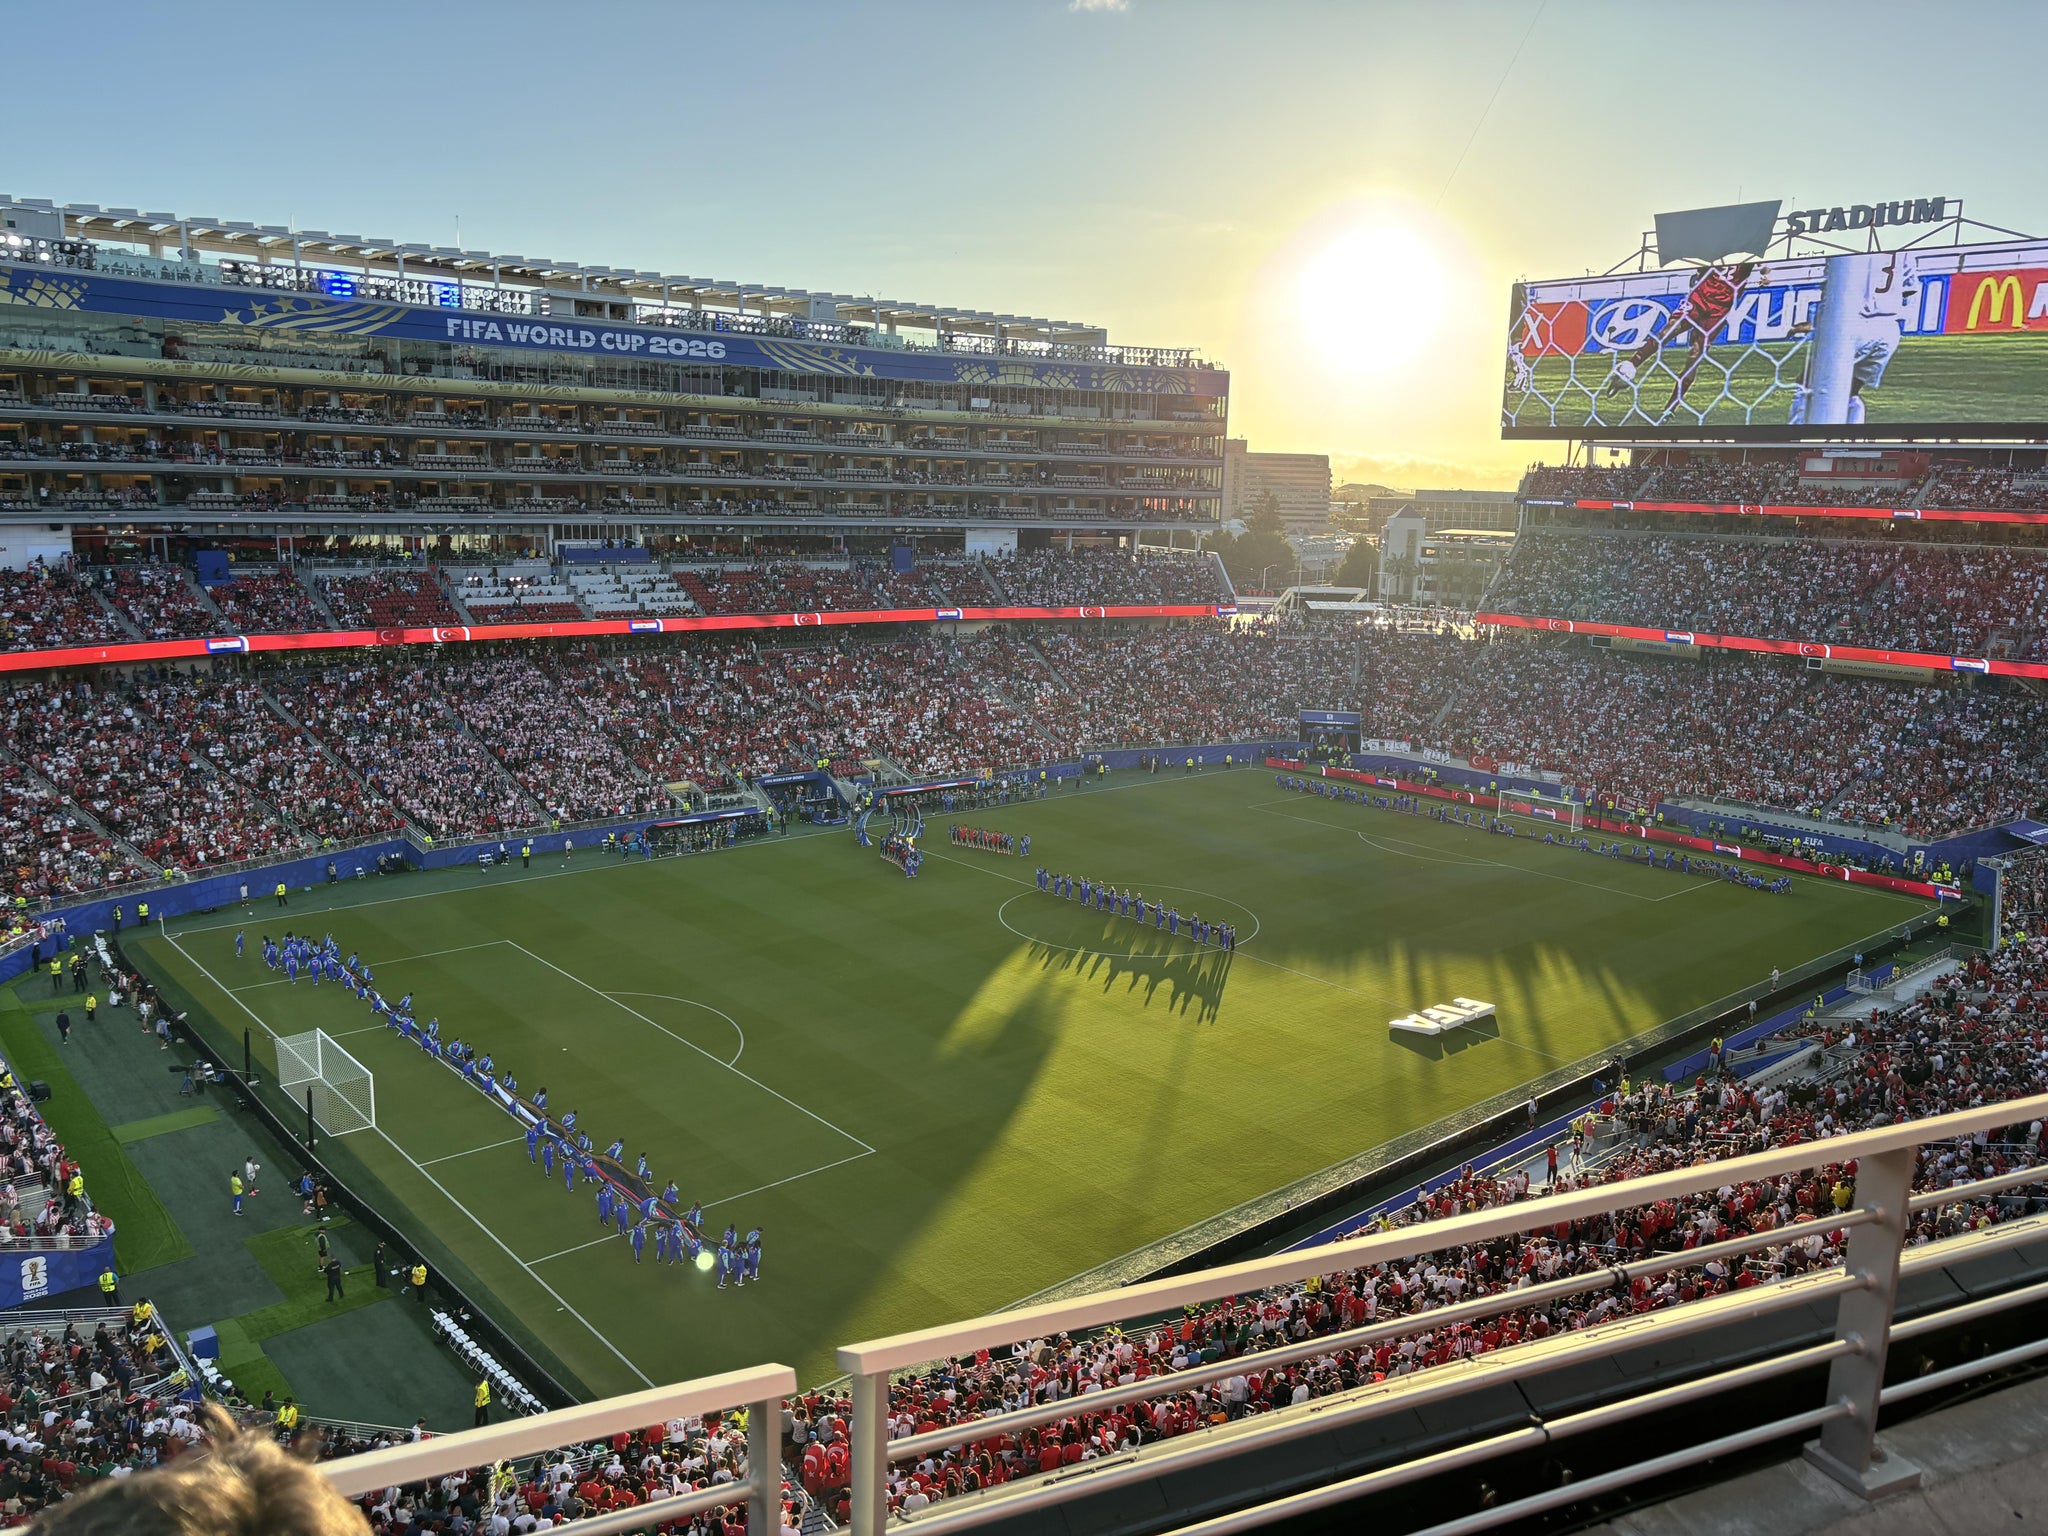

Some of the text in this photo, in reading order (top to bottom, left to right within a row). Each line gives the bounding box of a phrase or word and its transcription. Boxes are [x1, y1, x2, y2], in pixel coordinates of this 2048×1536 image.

[1786, 196, 1946, 237] STADIUM
[446, 317, 727, 360] FIFA WORLD CUP 2026
[1843, 664, 1887, 673] FRANCISCO
[23, 1290, 48, 1300] 2026
[673, 1423, 683, 1433] 34
